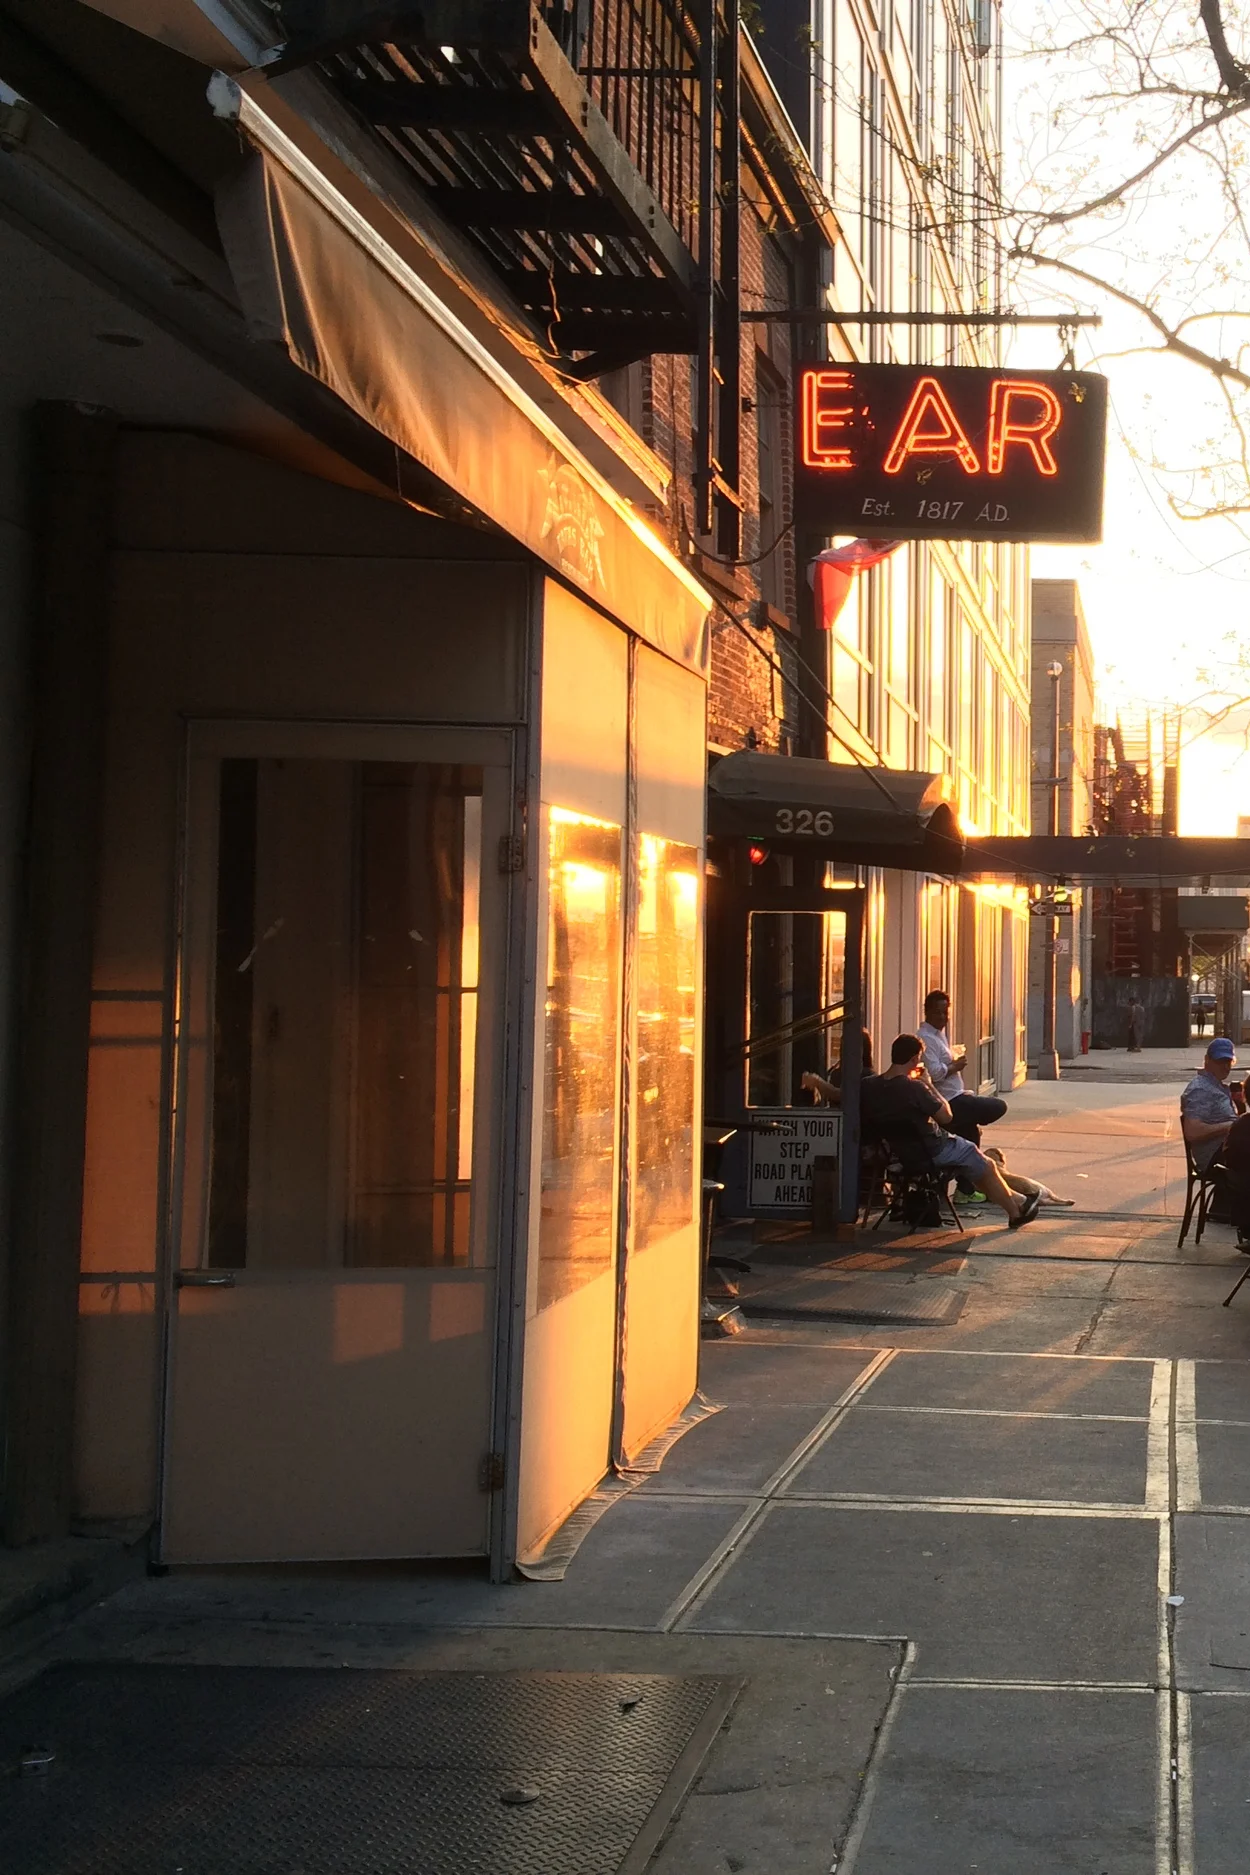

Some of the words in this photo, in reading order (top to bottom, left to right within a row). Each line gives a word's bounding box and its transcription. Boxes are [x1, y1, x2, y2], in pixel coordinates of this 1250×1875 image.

[802, 370, 1062, 476] EAR
[861, 497, 895, 517] Est.
[916, 499, 964, 521] 1817
[976, 501, 1011, 523] A.D.
[775, 808, 835, 837] 326
[803, 1120, 834, 1138] YOUR
[780, 1142, 810, 1159] STEP
[754, 1163, 786, 1180] ROAD
[791, 1164, 815, 1181] PLA
